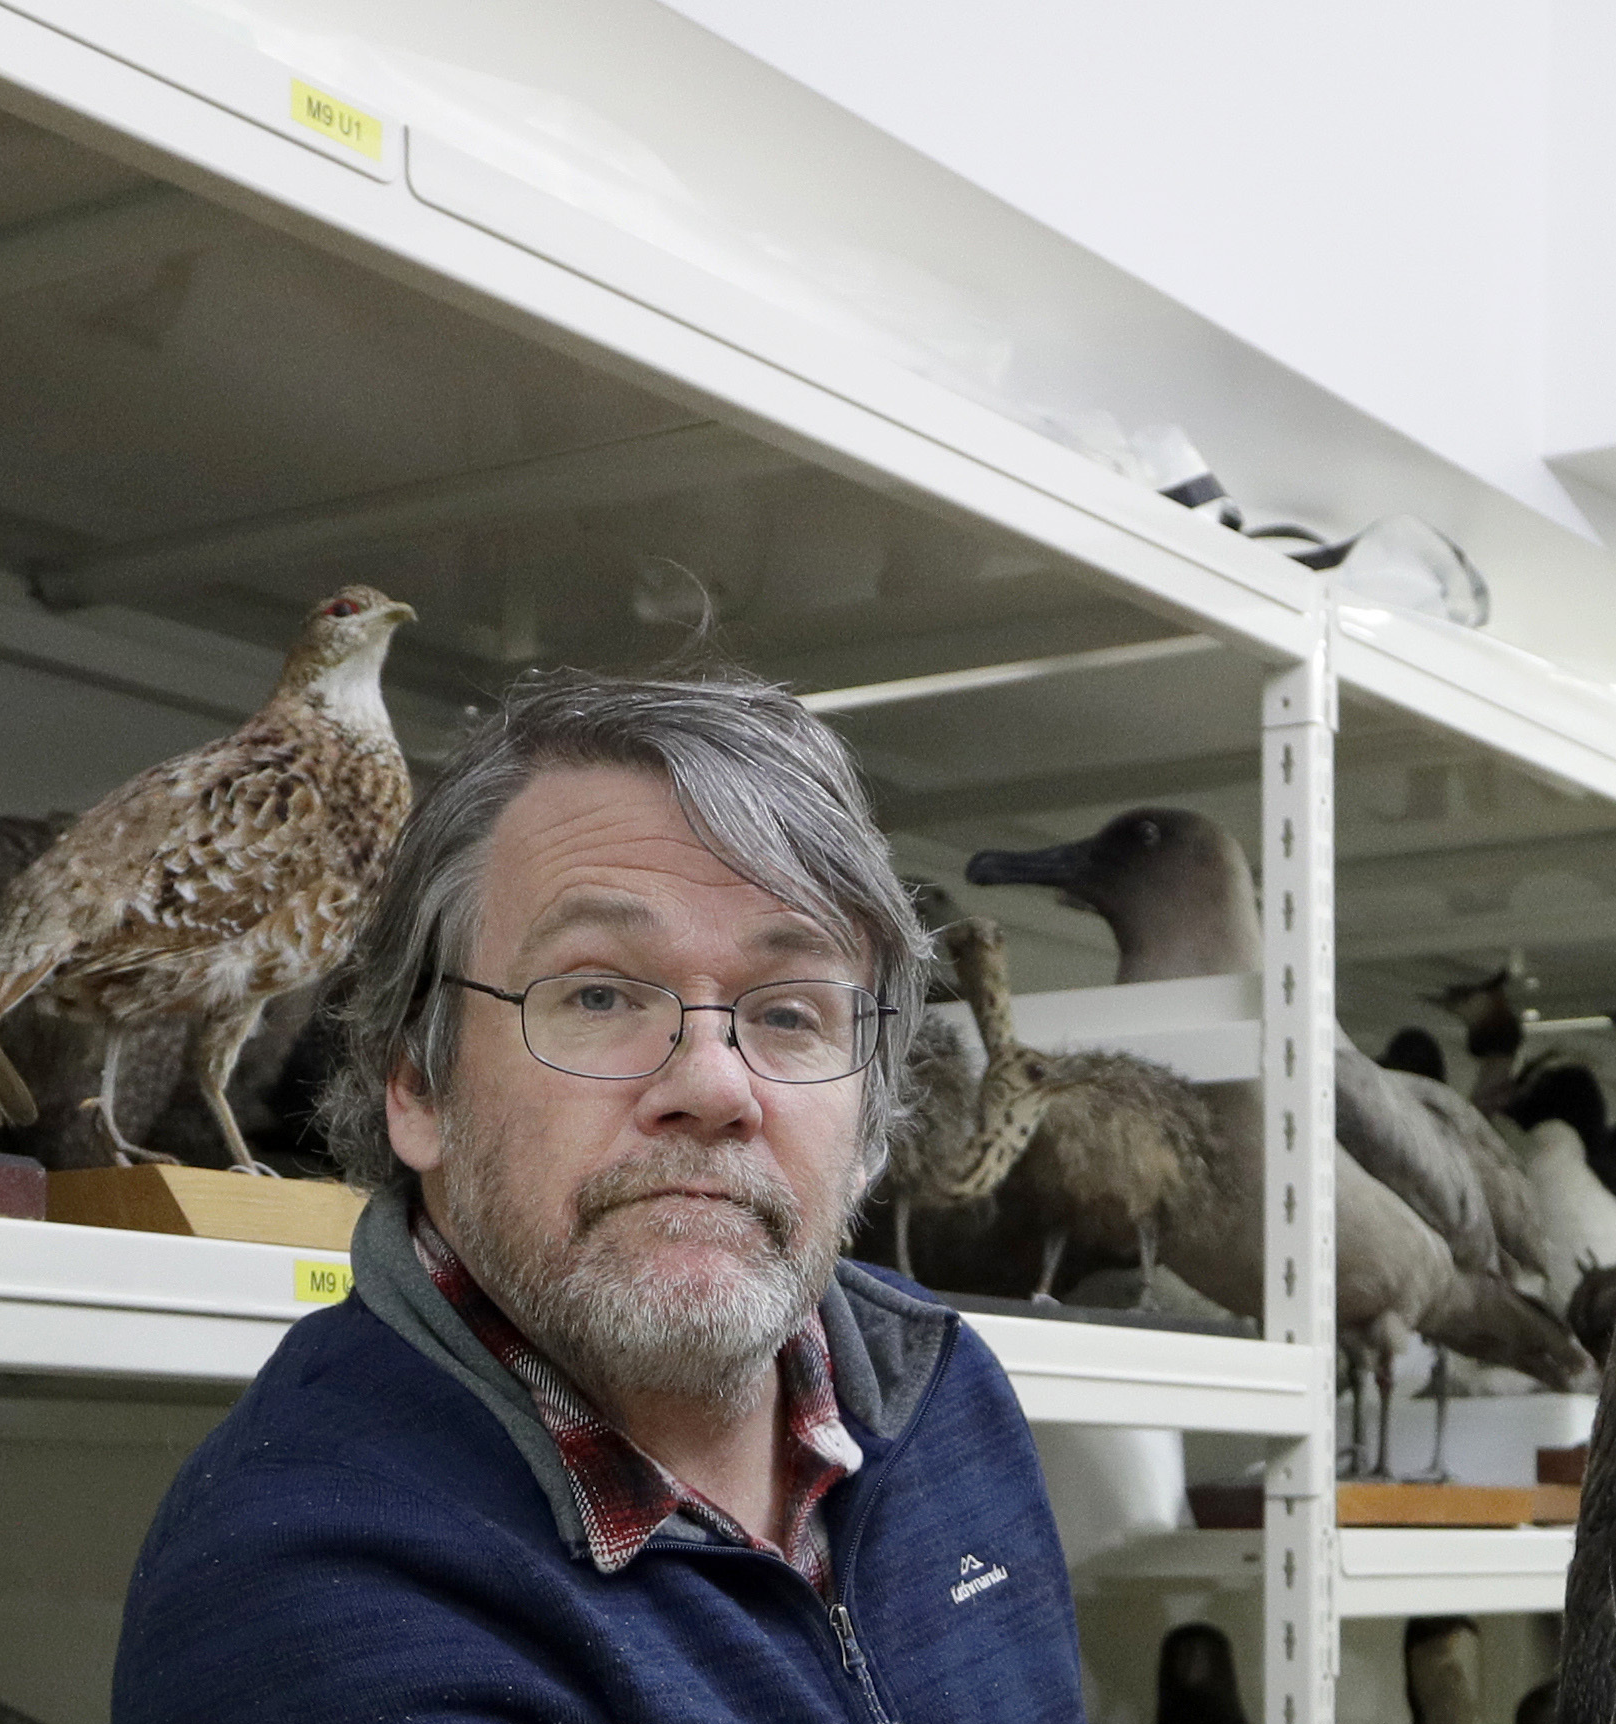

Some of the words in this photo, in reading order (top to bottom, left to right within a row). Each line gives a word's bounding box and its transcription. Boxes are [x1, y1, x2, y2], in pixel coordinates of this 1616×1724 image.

[306, 95, 333, 126] M9
[338, 110, 362, 142] U1
[310, 1270, 336, 1293] M9
